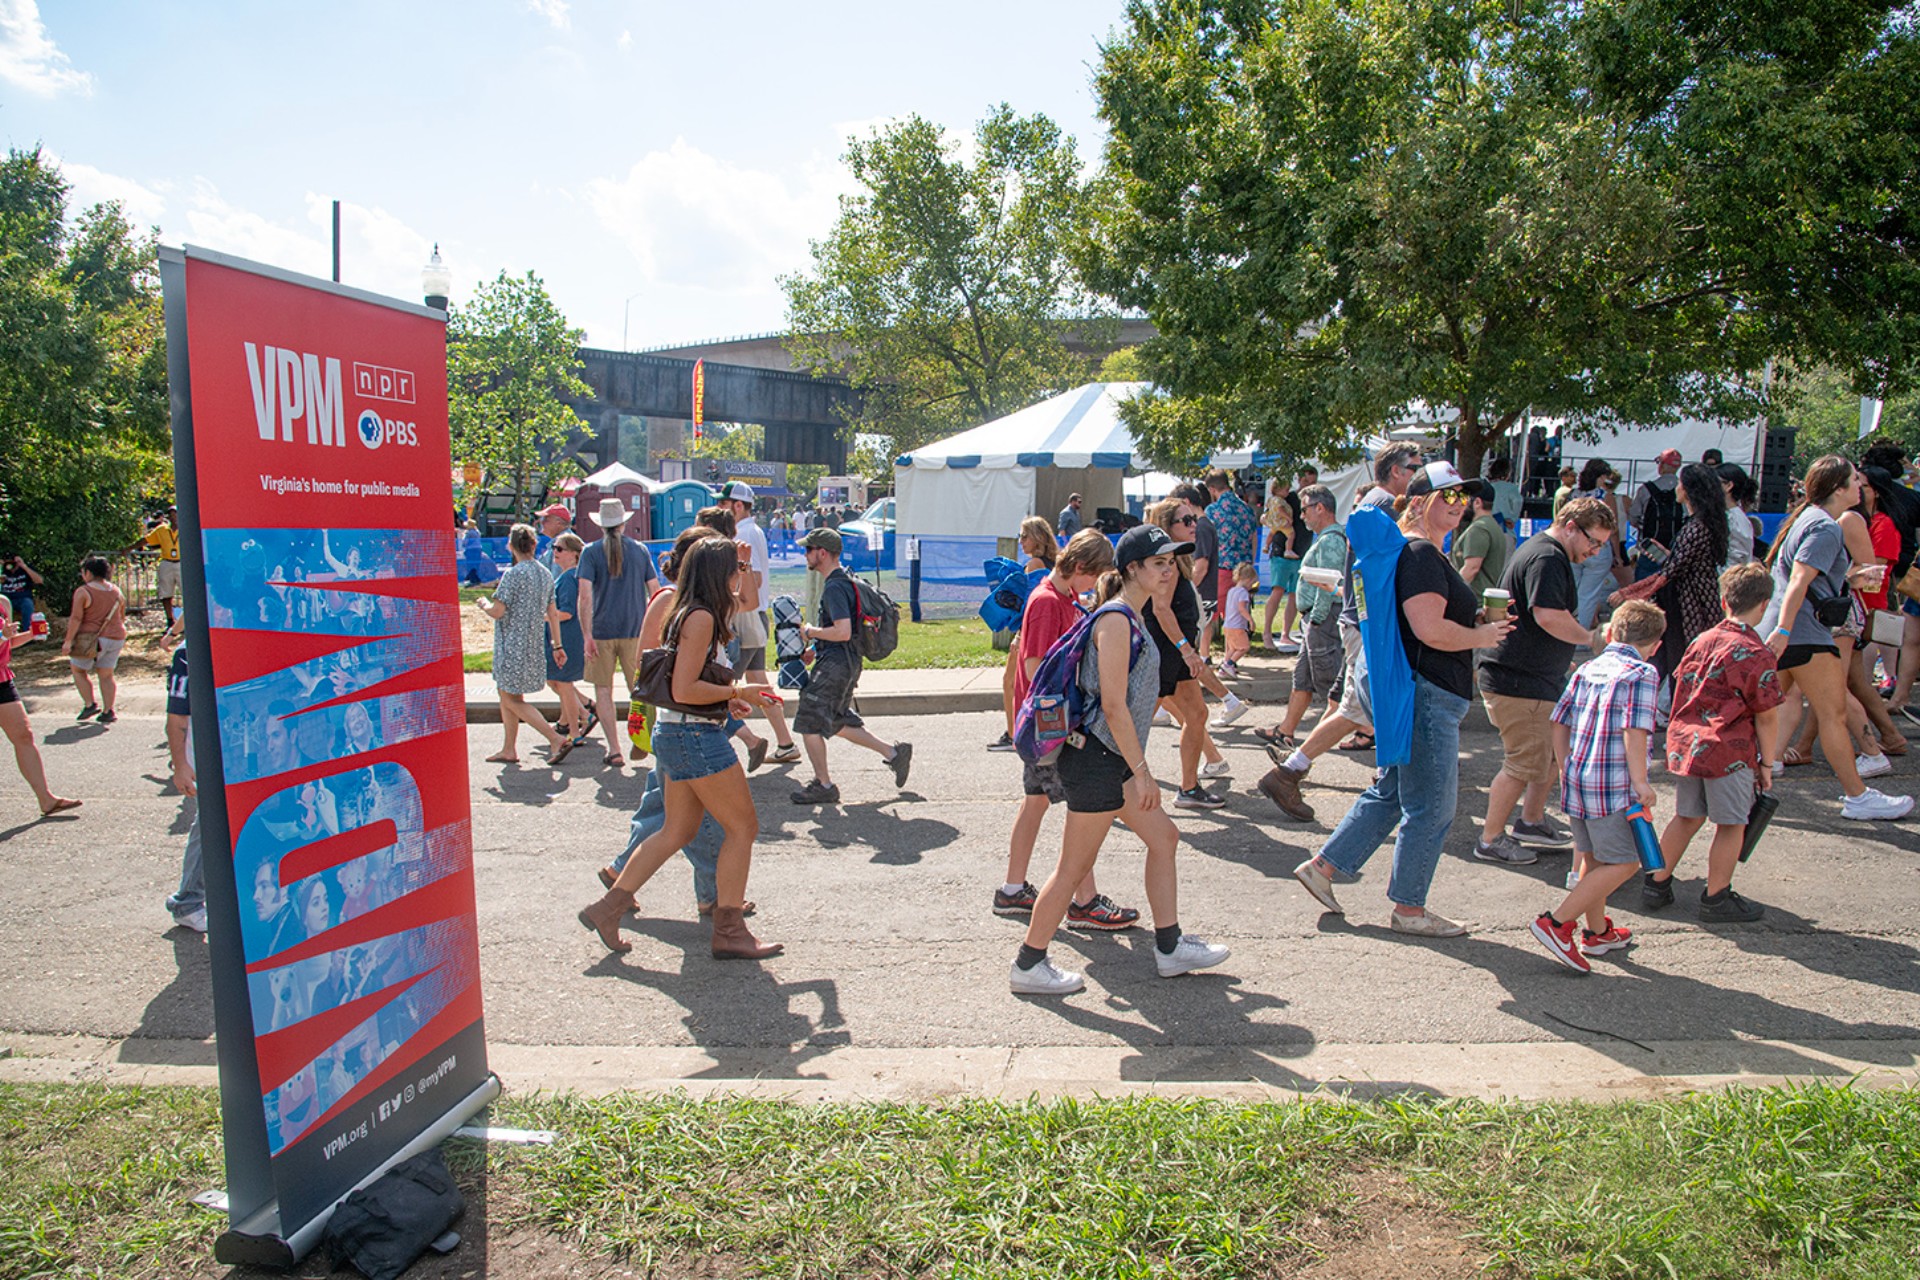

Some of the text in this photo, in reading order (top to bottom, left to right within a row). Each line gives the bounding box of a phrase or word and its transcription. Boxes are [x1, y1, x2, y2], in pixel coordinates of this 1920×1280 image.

[244, 341, 346, 448] VPM
[359, 369, 410, 398] npr
[385, 419, 418, 446] PBS
[259, 474, 421, 498] Virginia's home for public media
[323, 1056, 456, 1161] VPM.org @myVPM
